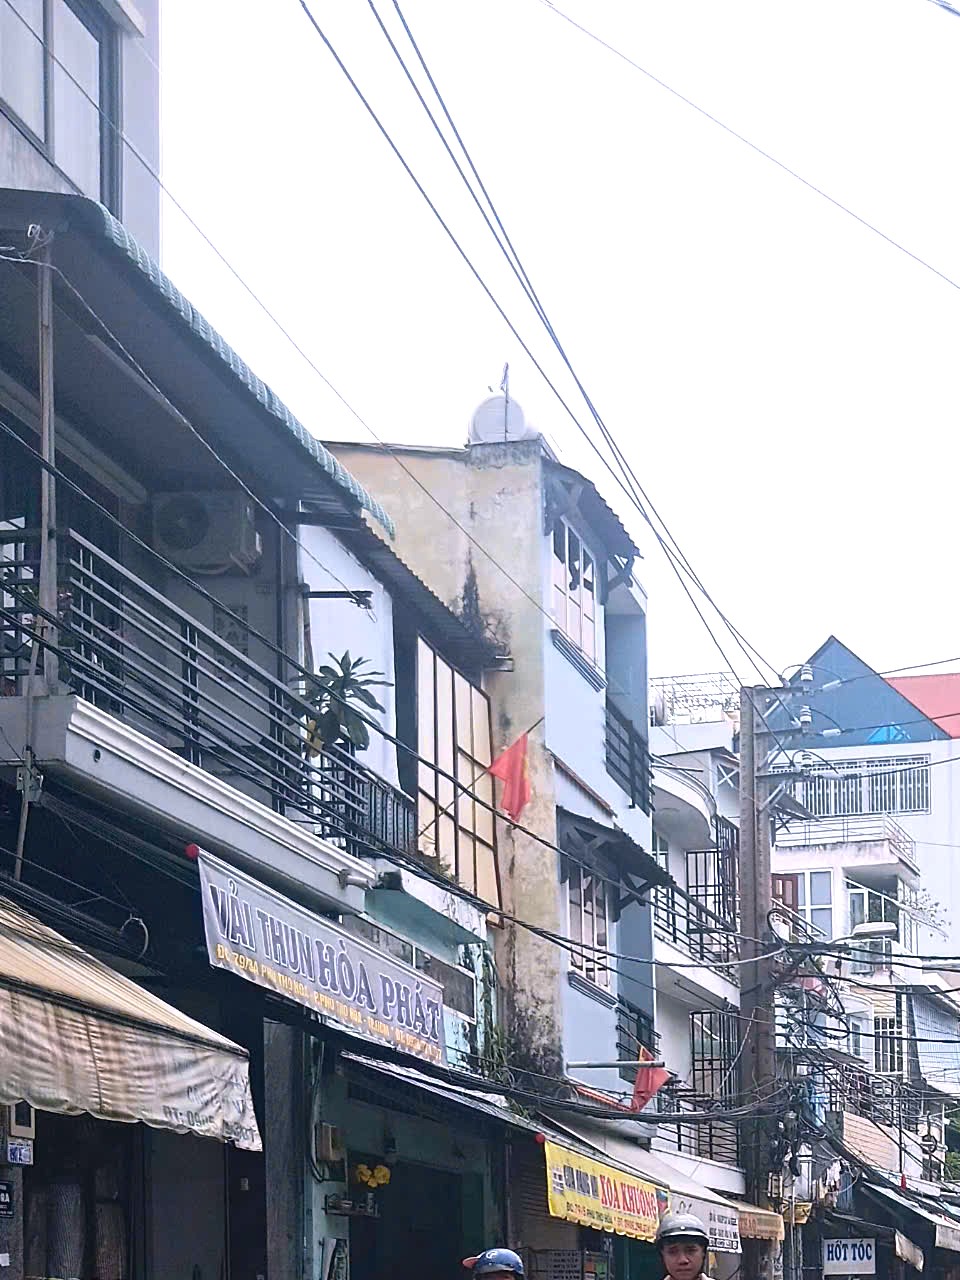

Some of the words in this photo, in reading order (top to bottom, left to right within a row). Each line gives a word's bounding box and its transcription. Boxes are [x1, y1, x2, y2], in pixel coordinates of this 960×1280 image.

[209, 878, 256, 952] VẢI
[256, 907, 316, 982] THUN
[315, 938, 378, 1014] HÒA
[379, 973, 441, 1042] PHÁT
[827, 1240, 848, 1261] HỚT
[851, 1240, 872, 1261] TÓC
